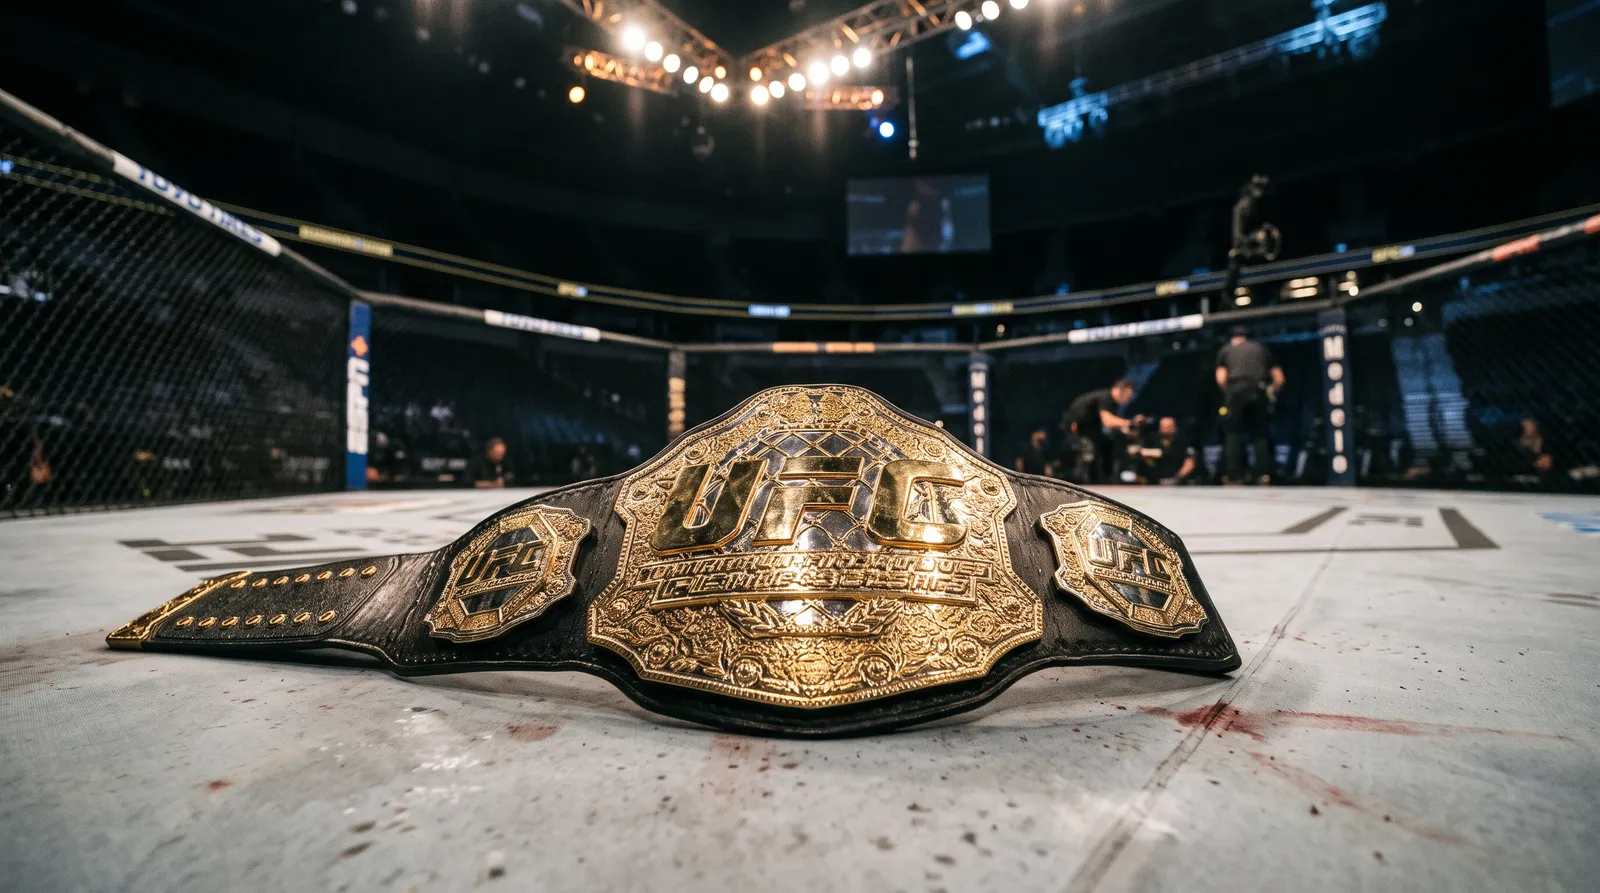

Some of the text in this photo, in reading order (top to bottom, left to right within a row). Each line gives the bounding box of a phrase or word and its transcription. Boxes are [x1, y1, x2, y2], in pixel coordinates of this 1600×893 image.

[651, 456, 969, 556] UFC
[456, 539, 548, 588] UFC
[1088, 536, 1171, 584] UFC
